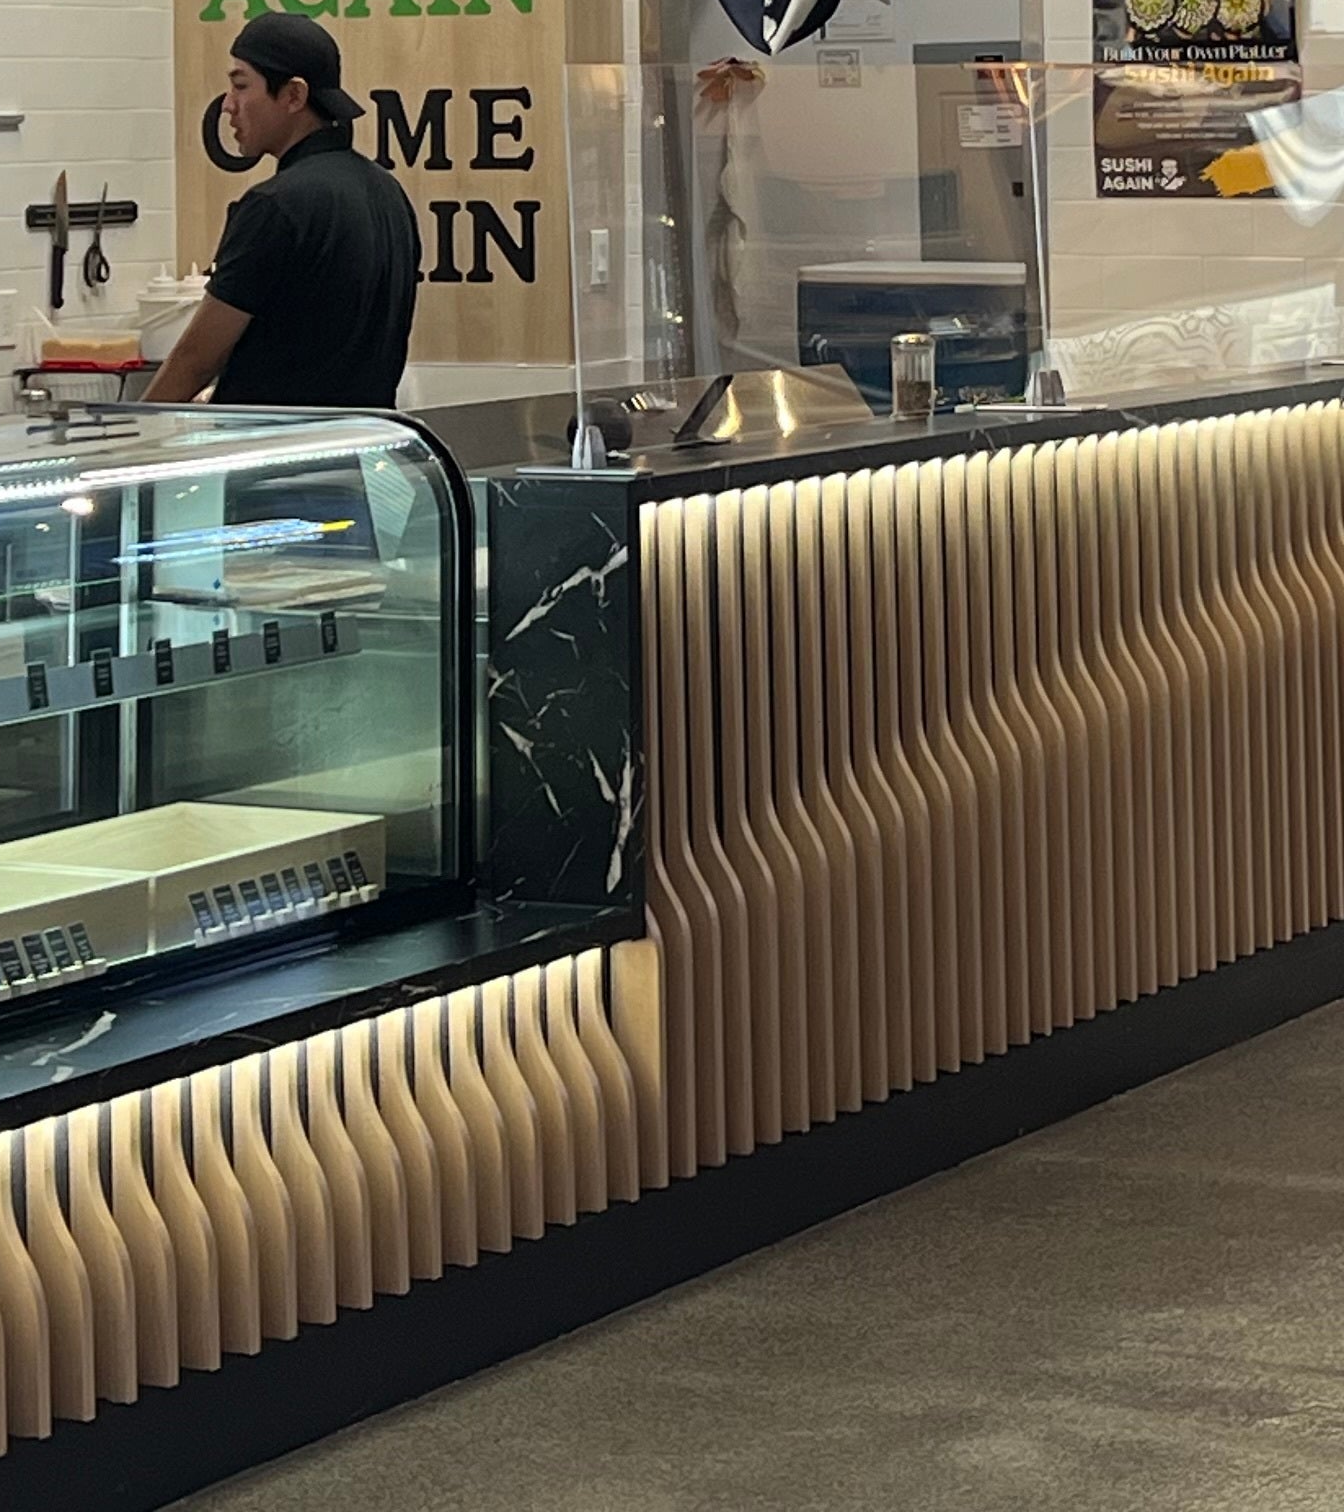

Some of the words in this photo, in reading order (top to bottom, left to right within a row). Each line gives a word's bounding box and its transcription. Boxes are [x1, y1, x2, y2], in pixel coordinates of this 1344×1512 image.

[1103, 45, 1142, 62] Build
[1145, 45, 1184, 62] Your
[1186, 45, 1228, 61] Own
[1229, 44, 1289, 61] Platter
[1203, 61, 1275, 88] Again
[1101, 157, 1153, 173] SUSHI
[1102, 175, 1154, 191] AGAIN
